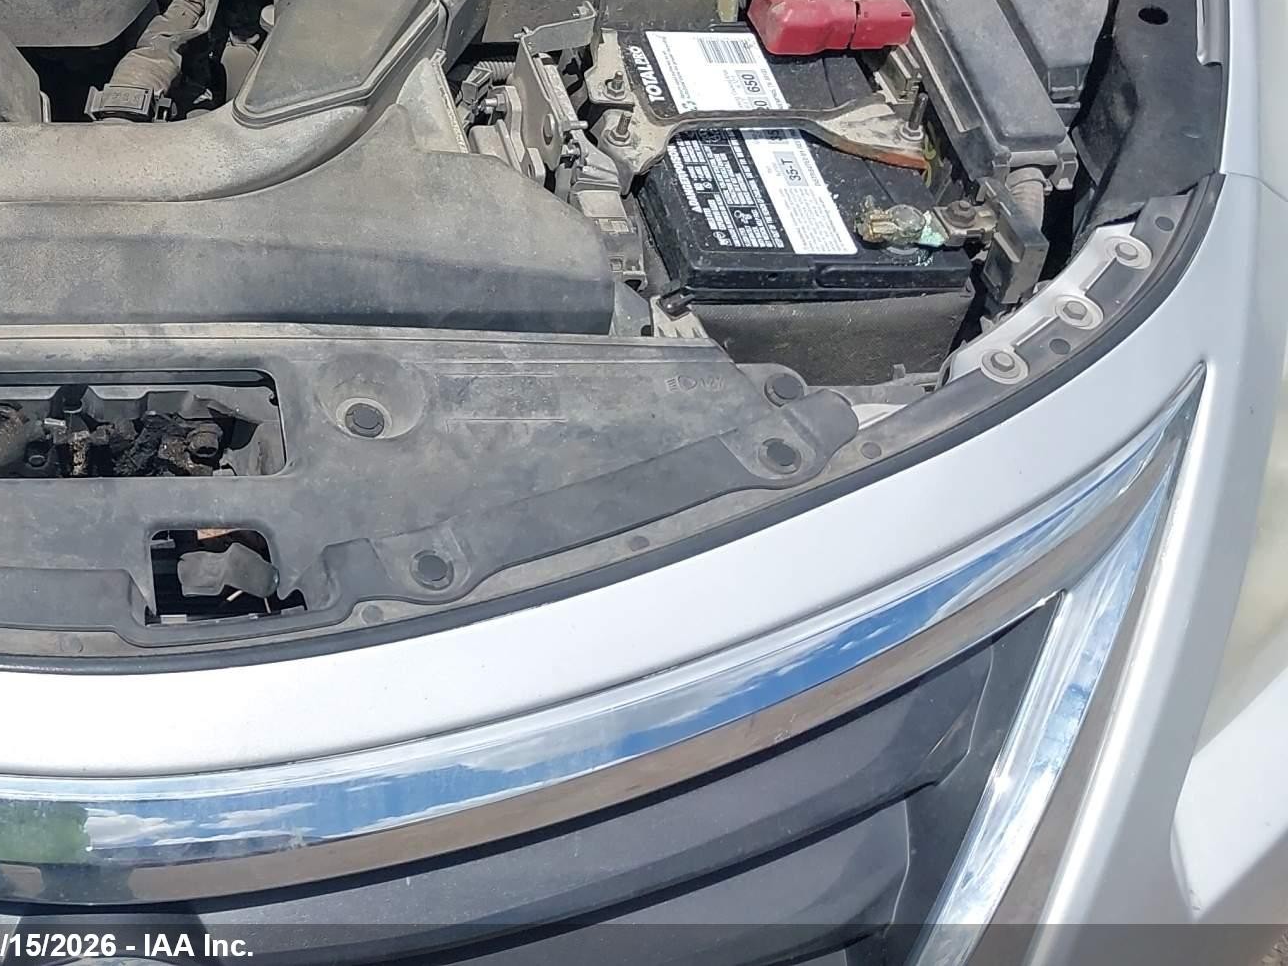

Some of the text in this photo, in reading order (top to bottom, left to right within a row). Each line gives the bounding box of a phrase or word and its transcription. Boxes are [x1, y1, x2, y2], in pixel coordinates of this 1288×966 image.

[629, 45, 665, 102] TOTALPRO
[741, 74, 760, 93] 650
[781, 158, 802, 181] 35-T
